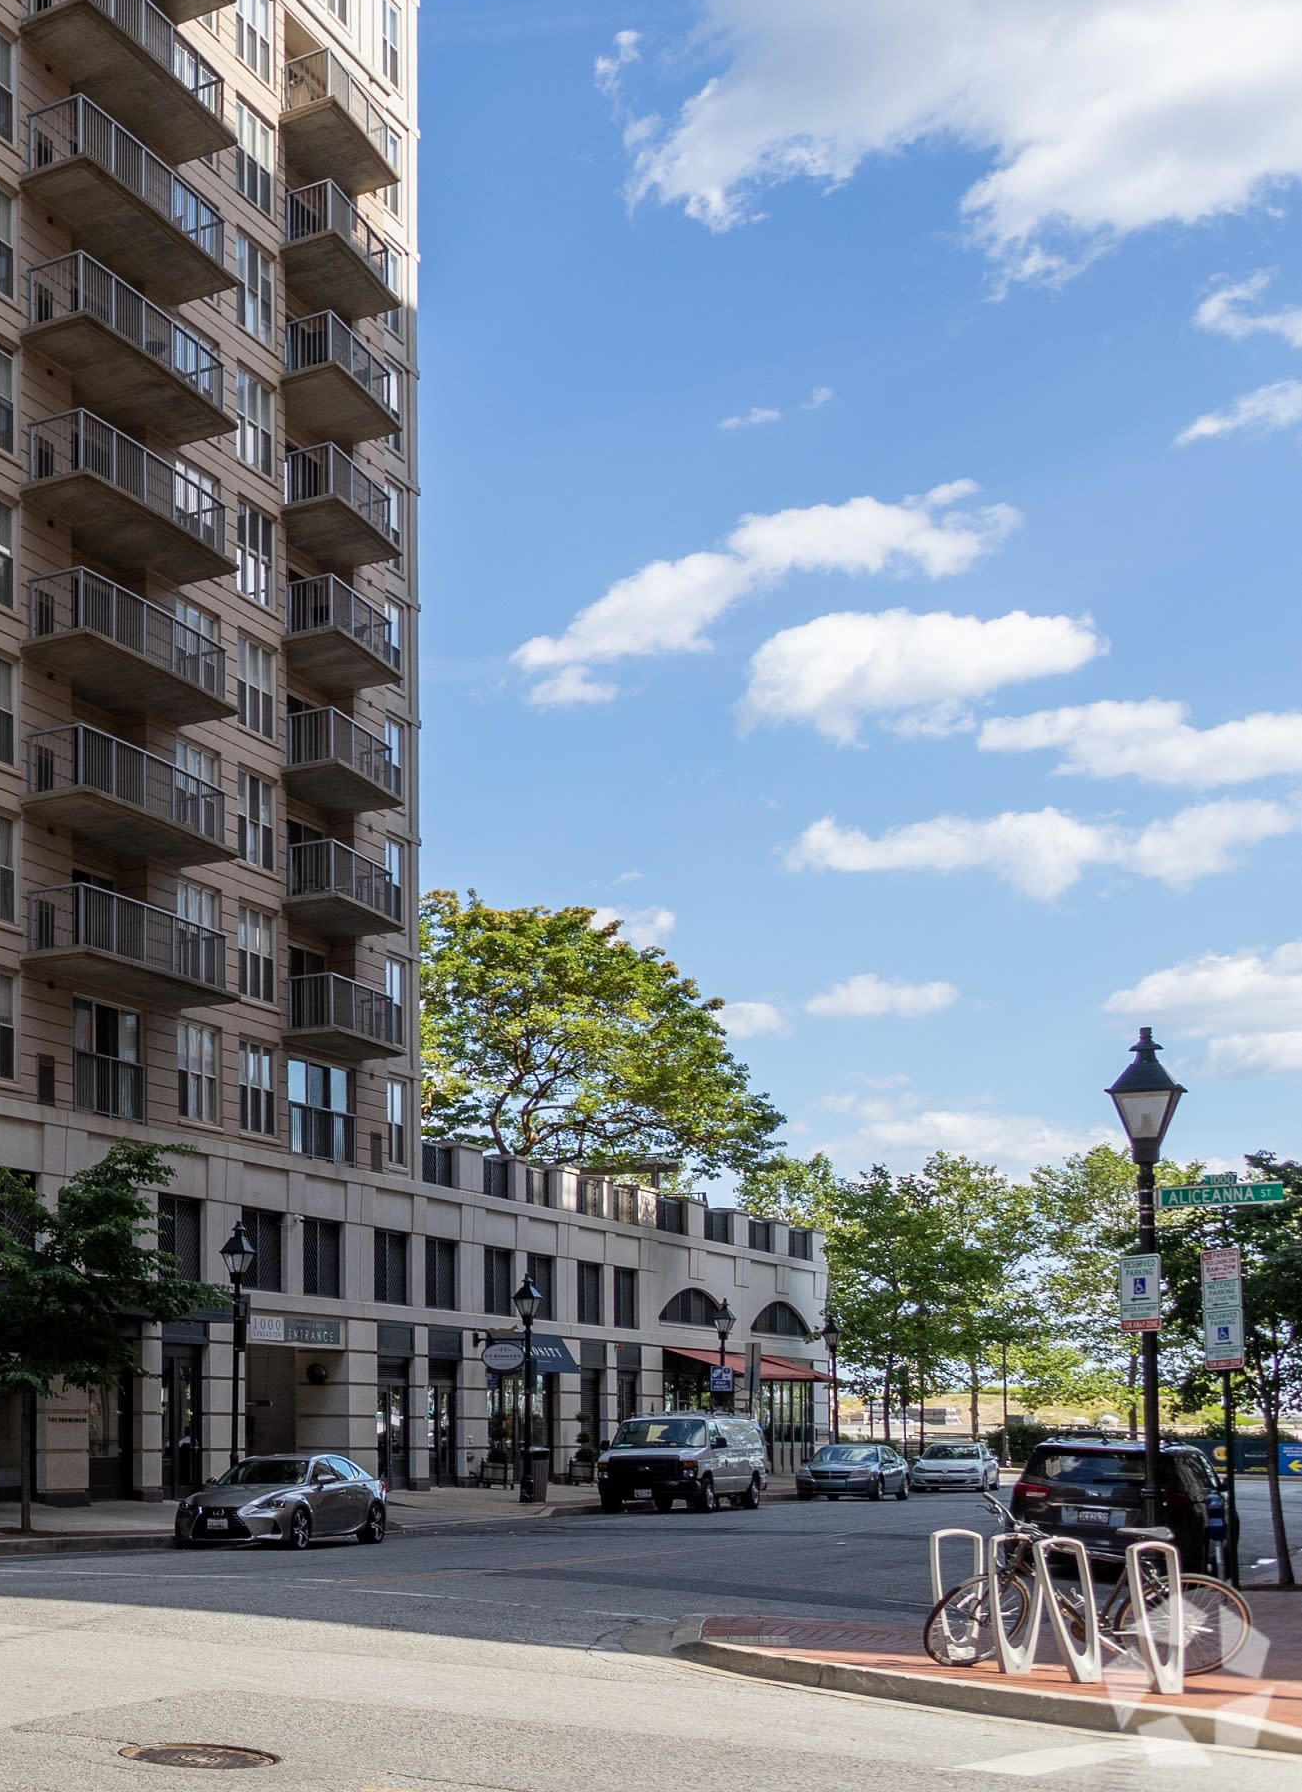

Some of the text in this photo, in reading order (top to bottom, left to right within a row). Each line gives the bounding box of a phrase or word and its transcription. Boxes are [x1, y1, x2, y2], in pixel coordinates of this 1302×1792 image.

[1210, 1175, 1234, 1185] 1000
[1168, 1187, 1255, 1205] ALICEANNA
[1123, 1259, 1155, 1268] RESERVED
[1126, 1268, 1153, 1277] PARKING
[253, 1318, 281, 1330] 1000
[288, 1328, 334, 1342] ENTRANCE
